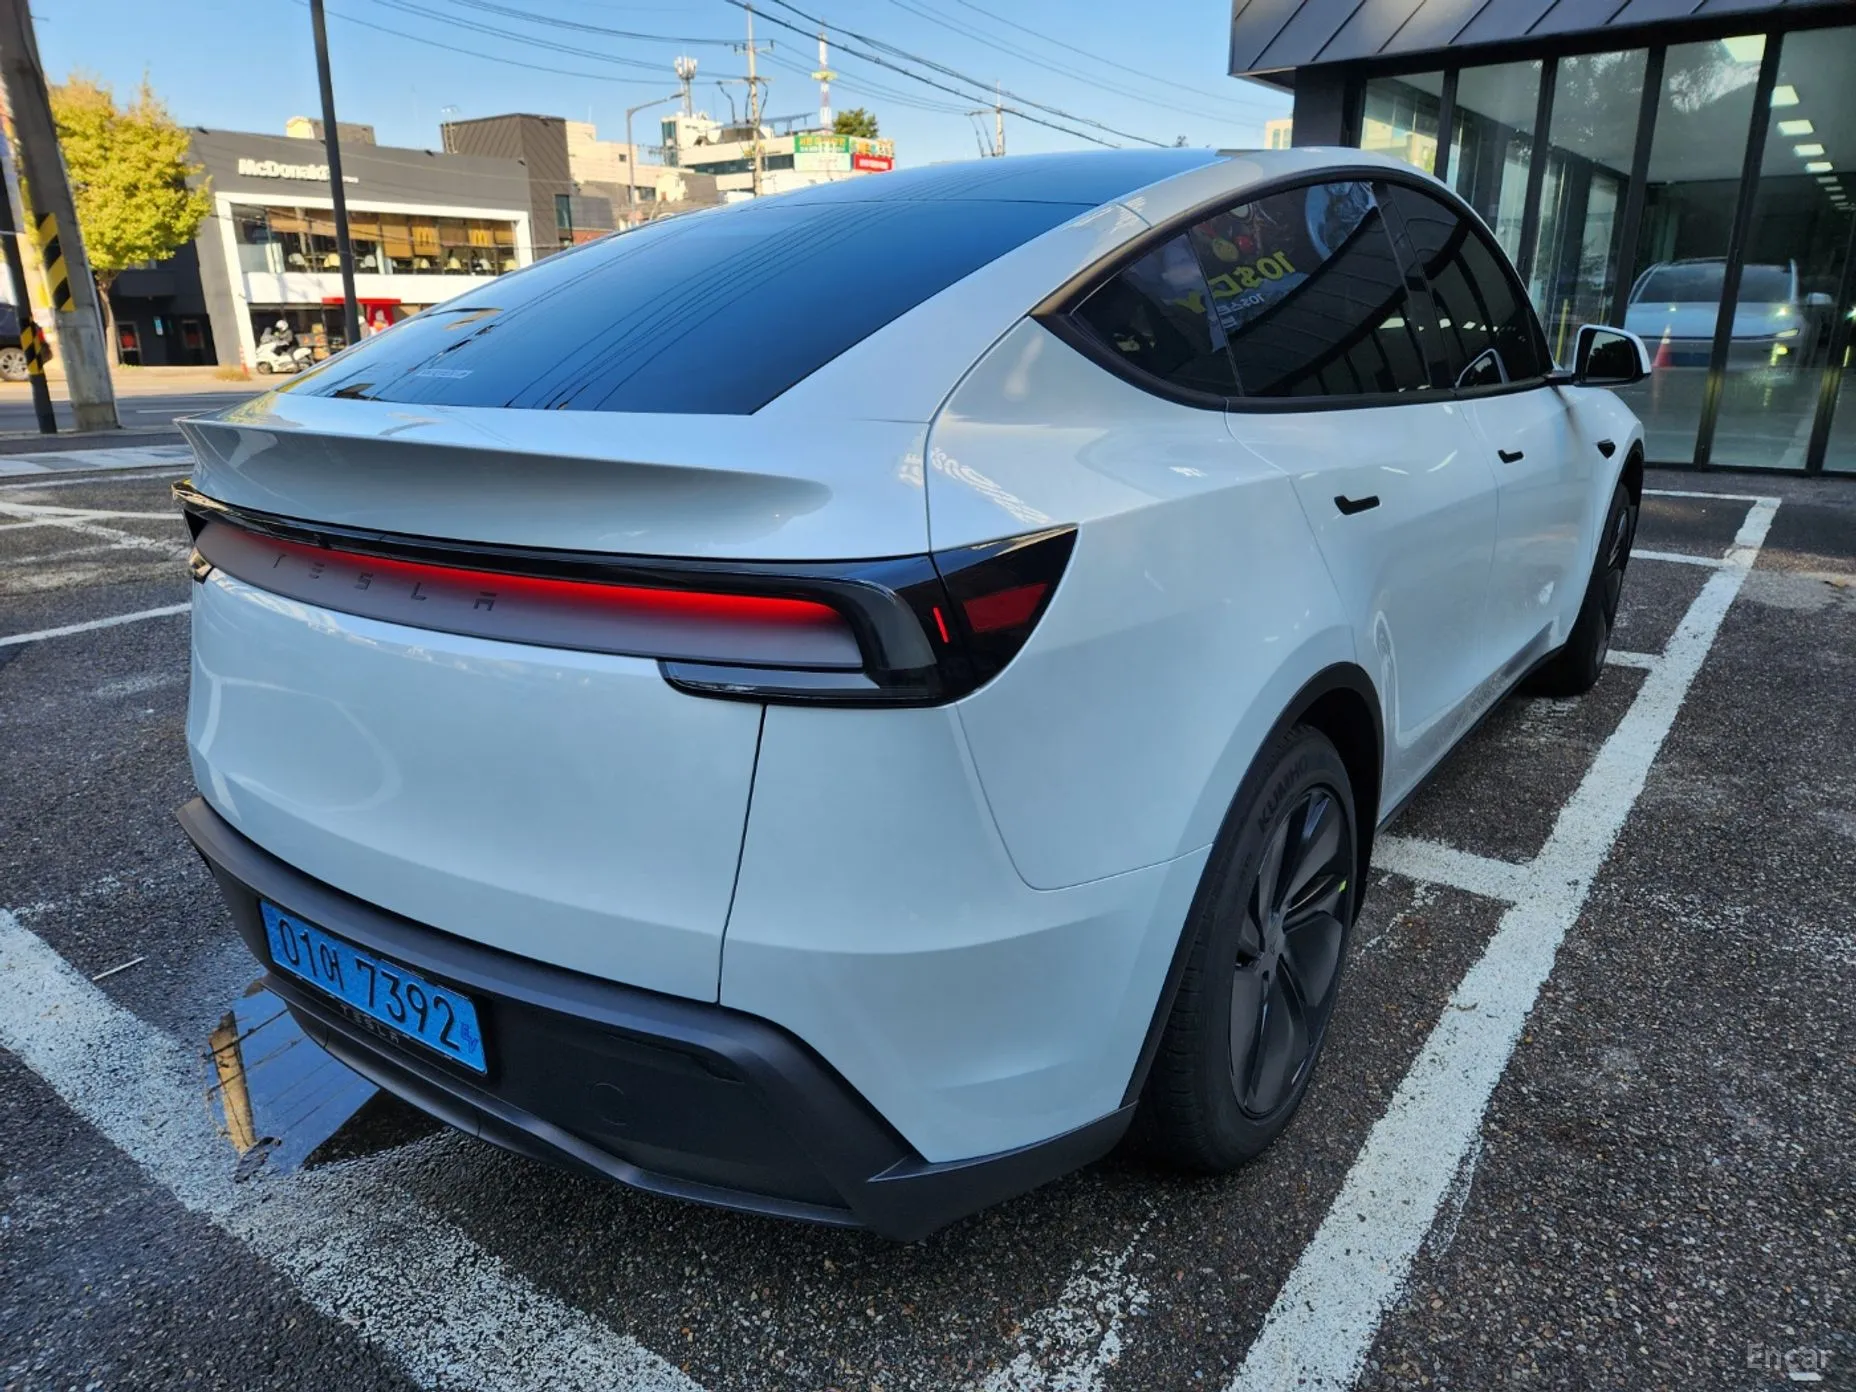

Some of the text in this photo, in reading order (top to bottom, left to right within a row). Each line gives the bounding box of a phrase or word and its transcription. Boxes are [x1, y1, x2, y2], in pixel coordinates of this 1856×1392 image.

[238, 158, 331, 182] McDonald
[272, 553, 497, 612] TESLA
[1258, 754, 1308, 834] KUMHO
[279, 918, 345, 991] 01어
[355, 956, 461, 1051] 7392
[339, 1003, 400, 1045] TESLA
